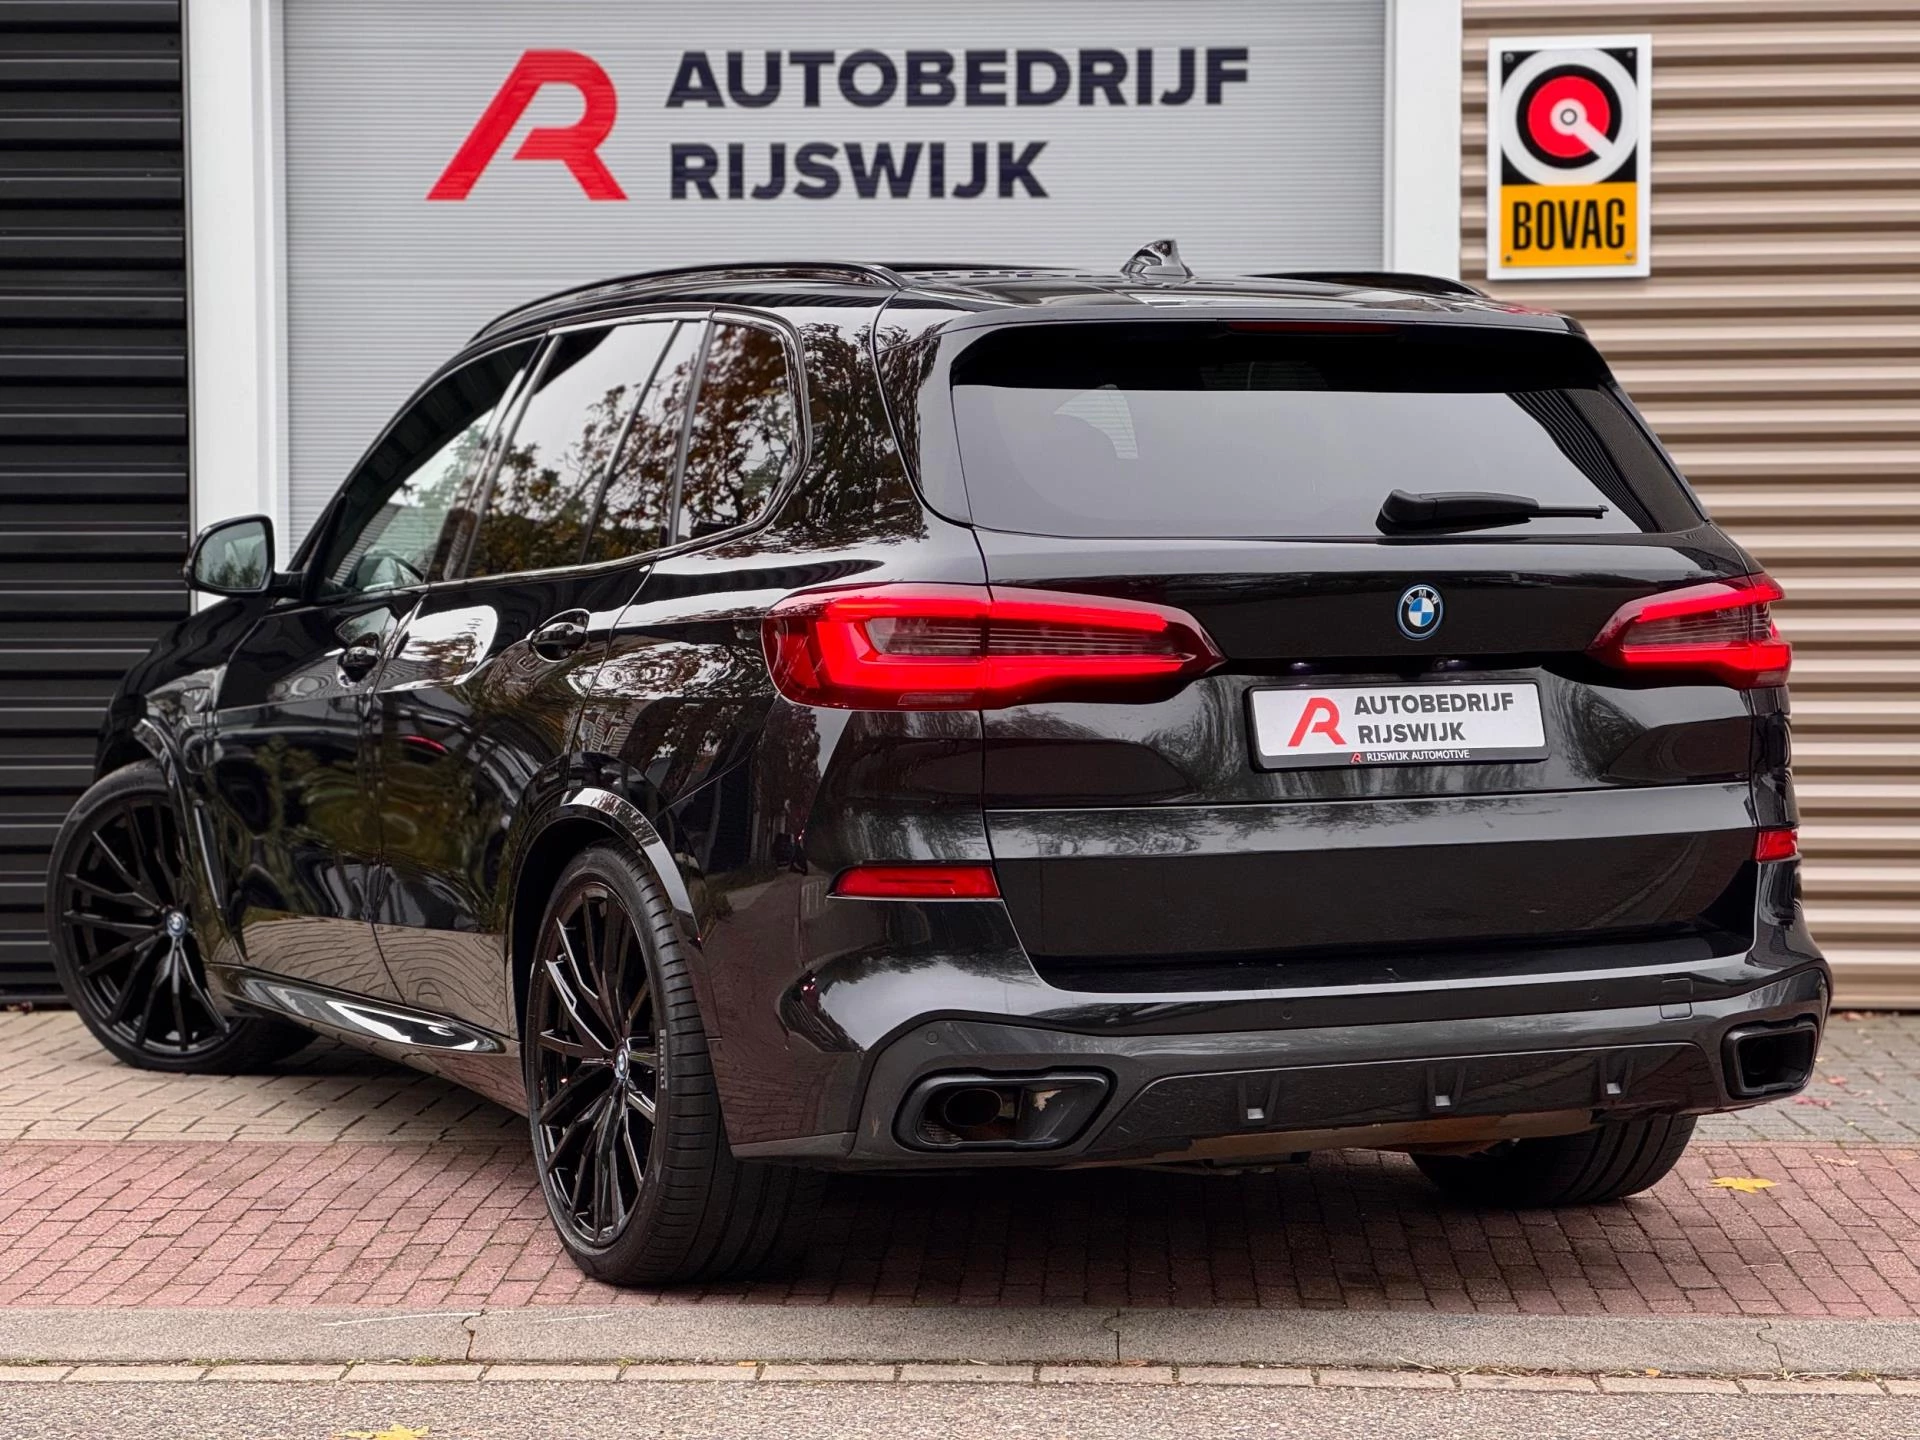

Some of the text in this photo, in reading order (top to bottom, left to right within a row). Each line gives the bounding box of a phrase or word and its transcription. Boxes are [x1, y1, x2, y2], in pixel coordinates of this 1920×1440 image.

[664, 46, 1250, 109] AUTOBEDRIJF
[670, 140, 1050, 201] RIJSWIJK
[1512, 198, 1626, 251] BOVAG
[1405, 589, 1440, 605] BMW
[1354, 692, 1515, 715] AUTOBEDRIJF
[1357, 722, 1466, 744] RIJSWIJK
[1366, 752, 1410, 762] RIJSWIJK
[1411, 749, 1471, 760] AUTOMOTIVE
